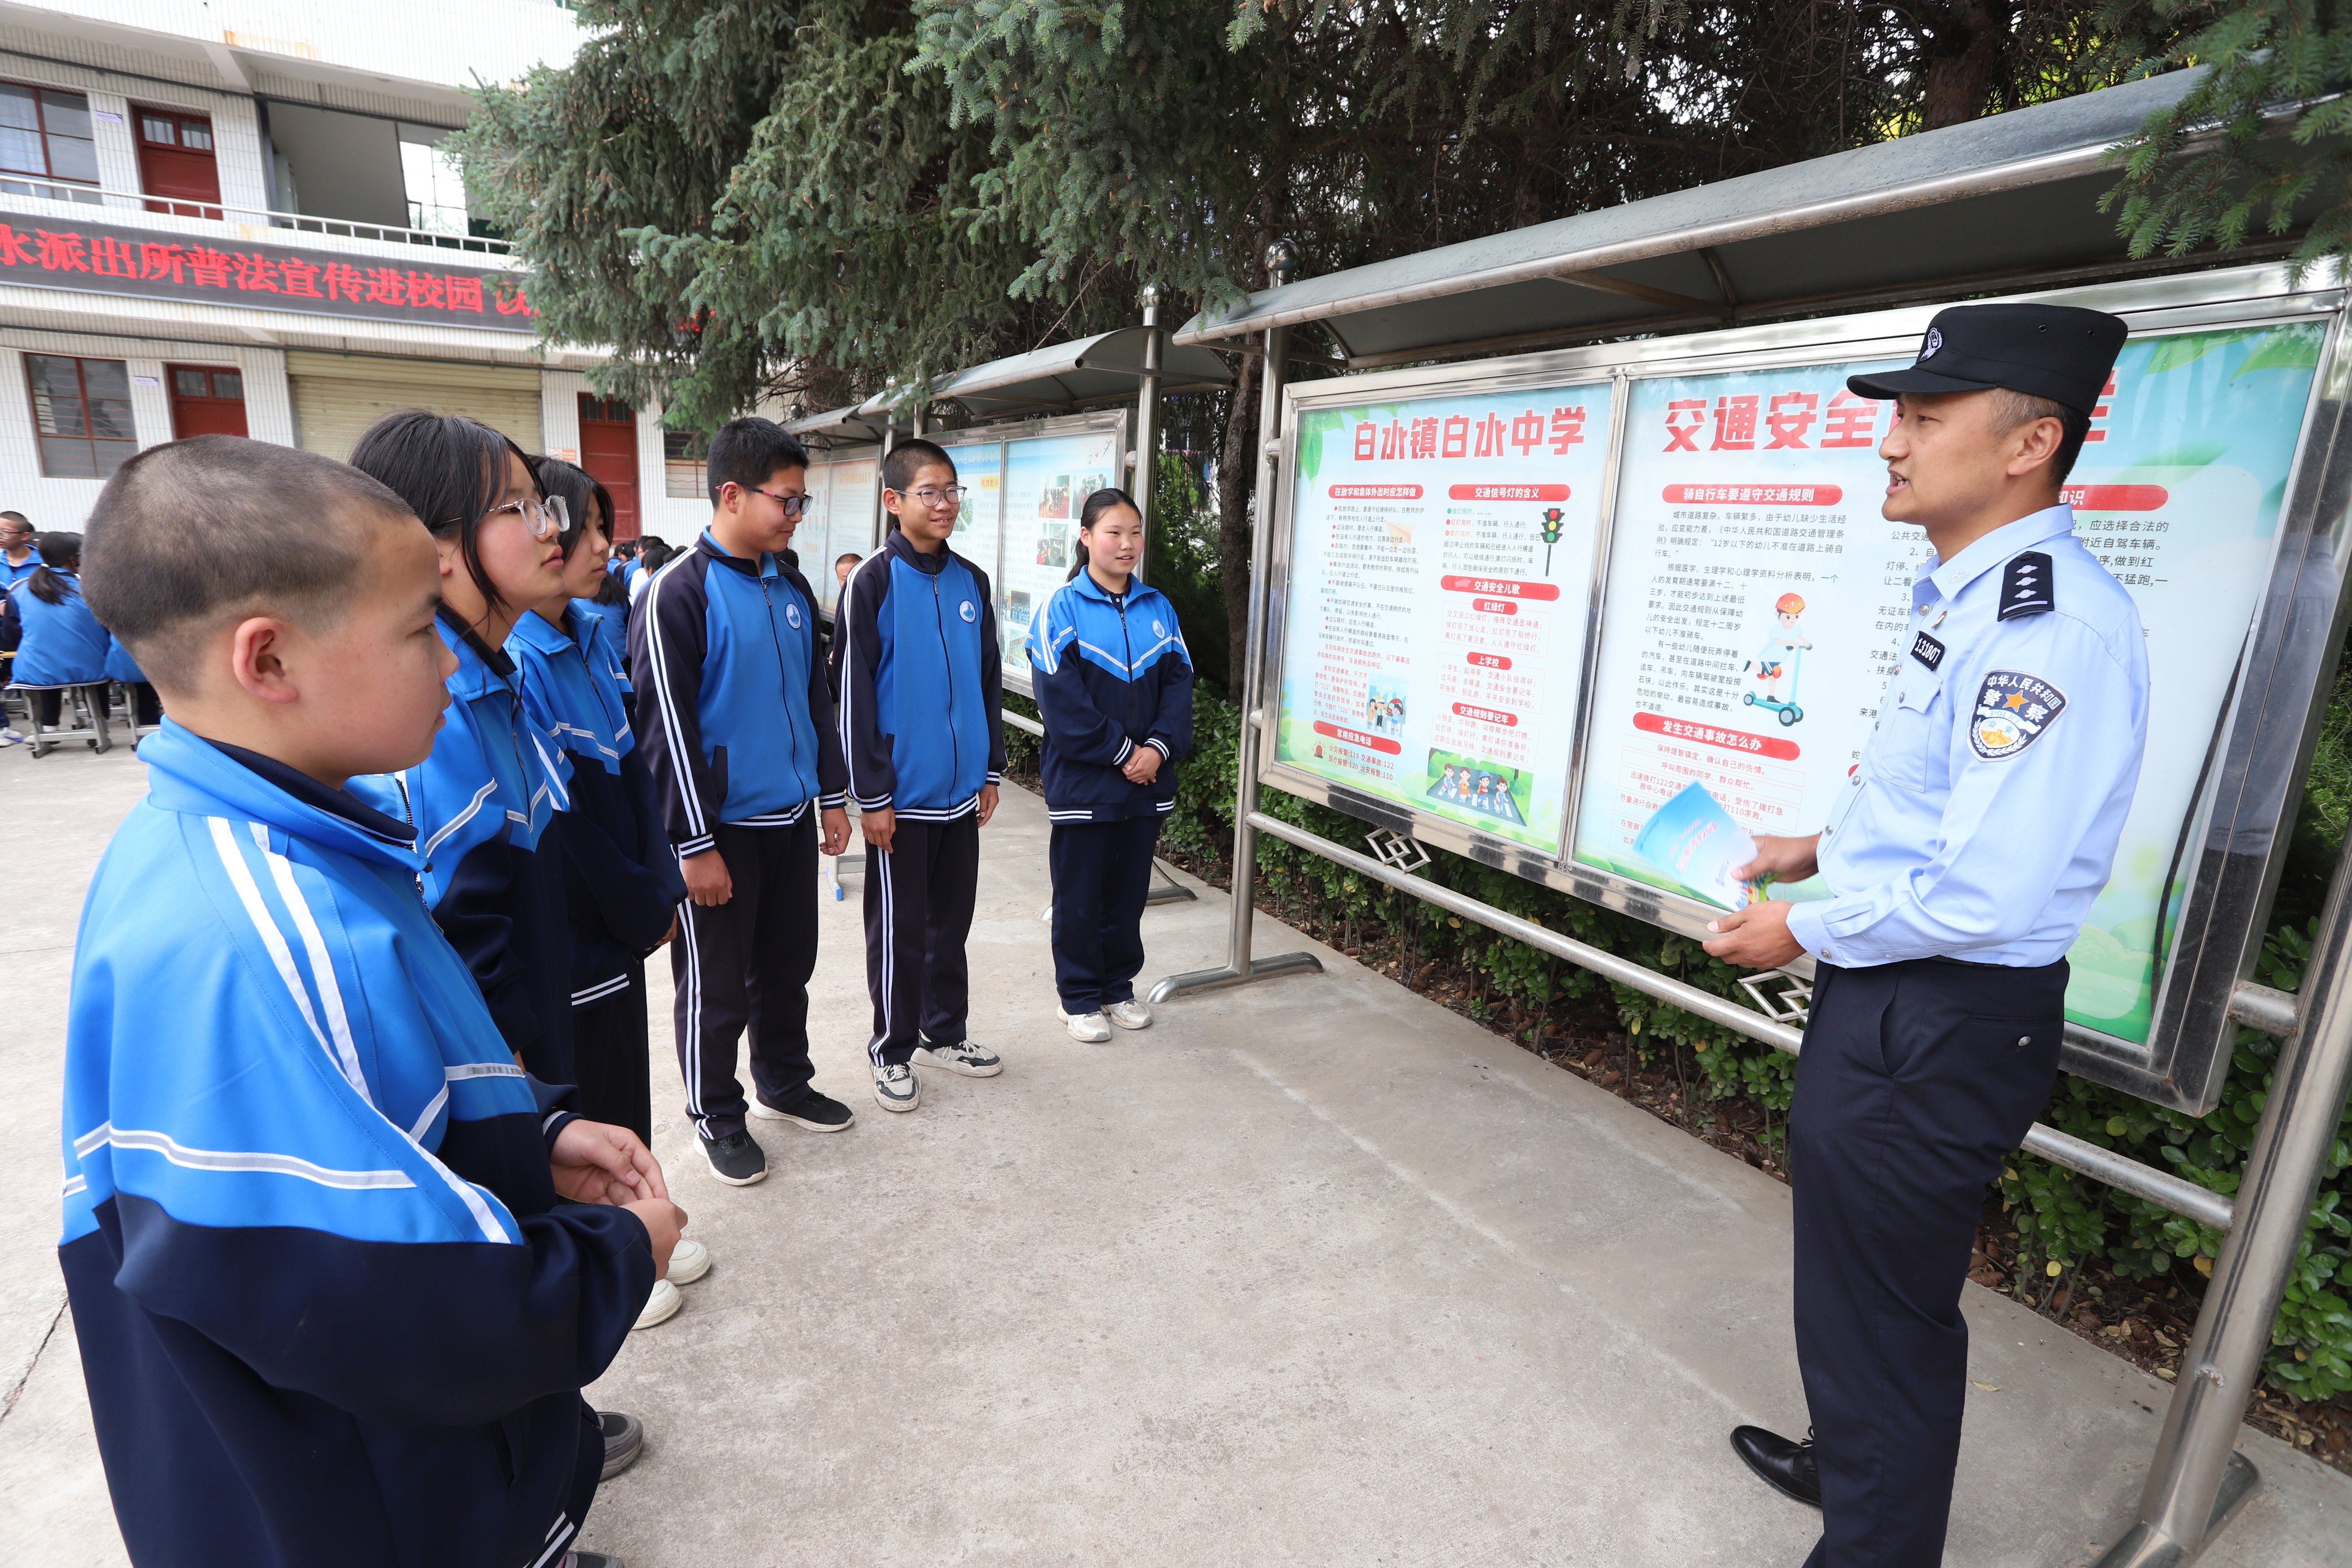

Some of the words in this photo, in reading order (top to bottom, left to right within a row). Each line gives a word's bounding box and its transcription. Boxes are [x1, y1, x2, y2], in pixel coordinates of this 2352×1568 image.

[0, 224, 483, 314] 水派出所普法宣传进校园
[1662, 389, 1899, 452] 交通安全
[1354, 406, 1586, 461] 白水镇白水中学
[981, 478, 999, 487] 教育教学
[1335, 487, 1416, 497] 在放学和集体外出时应怎样做
[1475, 487, 1540, 498] 交通信号灯的含义
[1683, 488, 1815, 502] 骑自行车要遵守交通规则
[1673, 511, 1847, 524] 城市道路复杂，车辆繁多，由于幼儿缺少生活经
[1335, 534, 1405, 543] 在没有人行道的地方，应靠路边行走。
[1444, 541, 1533, 553] 超过停止线的车辆和已经进入人行横道
[2092, 555, 2154, 567] 序,做到红
[1668, 563, 1839, 583] 根据医学、生理学和心理学资料分析表明，一个
[1474, 580, 1521, 595] 交通安全儿歌
[1651, 575, 1747, 590] 人的发育期通常要满十二、十
[1650, 588, 1745, 604] 三岁，才能初步达到上述最低
[1484, 601, 1505, 613] 红绿灯
[1648, 600, 1743, 617] 要求。因此交通规则从保障幼
[1646, 613, 1741, 631] 儿的安全出发，规定十二周岁
[1645, 626, 1704, 640] 以下幼儿不准骑车。
[1445, 632, 1540, 652] 黄灯亮了要注意，人人遵守红绿灯。
[1658, 640, 1738, 658] 有一些幼儿随便玩弄停着
[1914, 638, 1941, 663] 131807
[1478, 655, 1499, 668] 上学校
[1642, 651, 1739, 672] 的汽车，甚至在道路中间拦车、
[1638, 675, 1739, 700] 石块，以此作乐。其实这是十分
[1987, 674, 2062, 710] 中华人民共和国
[1439, 684, 1534, 709] 听指挥，别乱跑，平平安安到学校。
[1459, 705, 1509, 724] 交通规则要记牢
[1635, 700, 1664, 713] 也不道德。
[1991, 710, 2022, 726] POLICE
[1337, 729, 1372, 746] 常用应急电话
[1436, 724, 1530, 752] 红灯停，绿灯行，黄灯请你准备好。
[1662, 720, 1762, 751] 发生交通事故怎么办
[1434, 734, 1529, 763] 过路应走斑马线，交通规则要记牢。
[1657, 744, 1765, 775] 保持理智镇定，确认自己的伤情。
